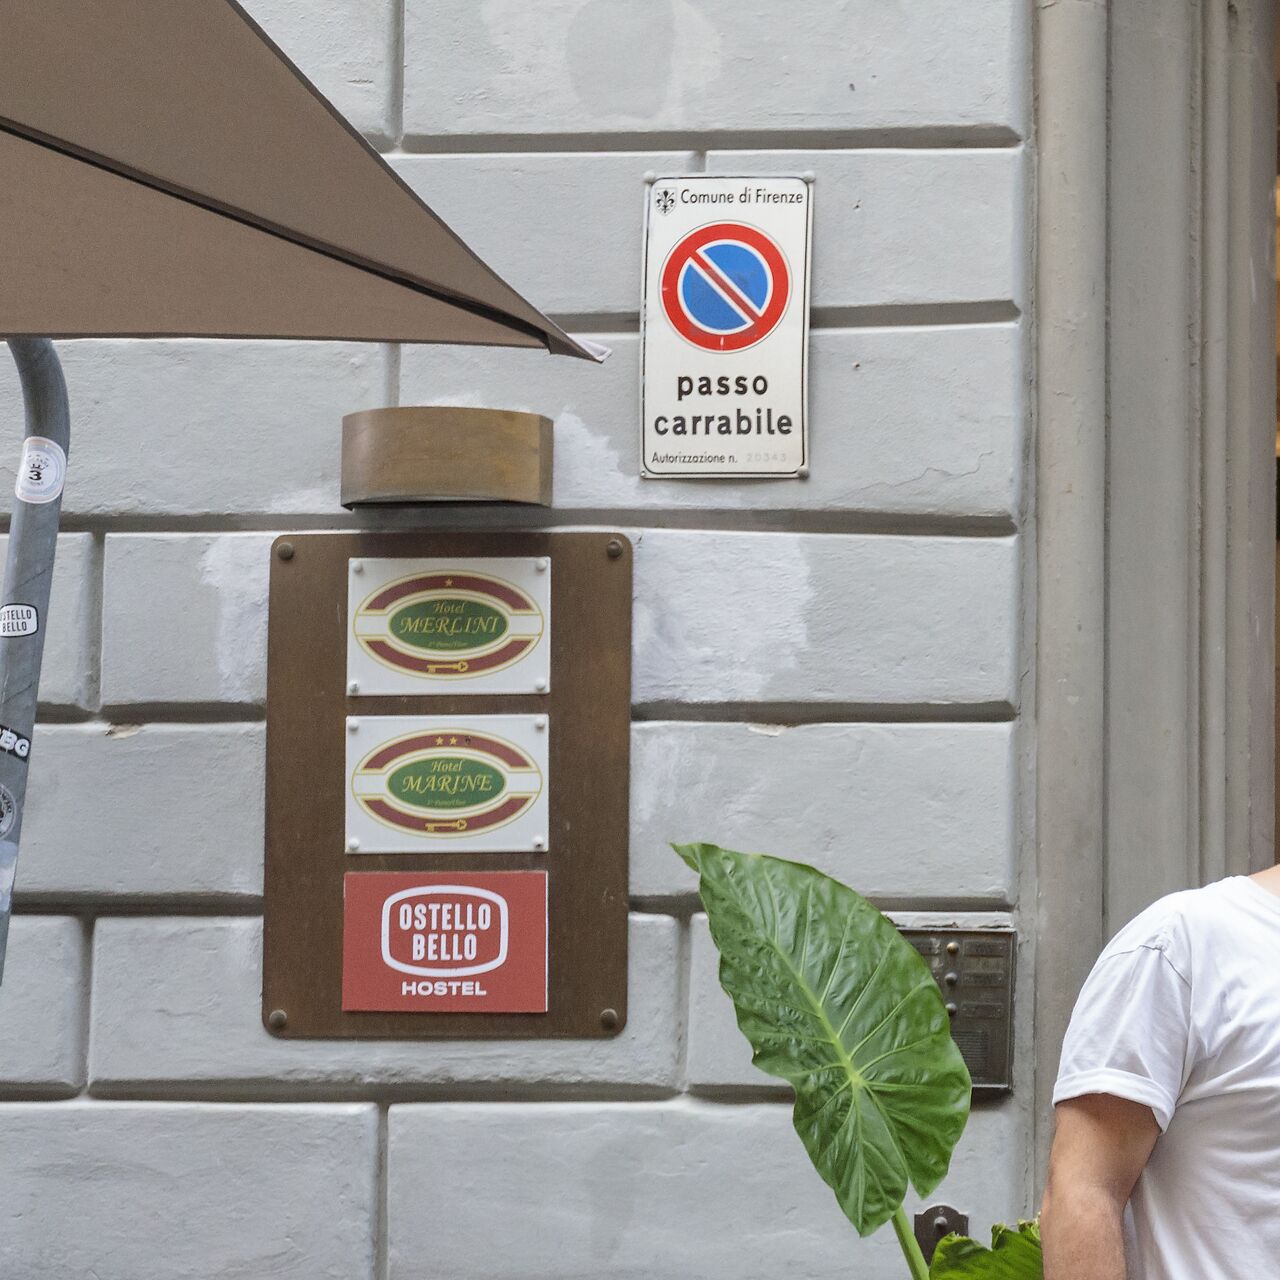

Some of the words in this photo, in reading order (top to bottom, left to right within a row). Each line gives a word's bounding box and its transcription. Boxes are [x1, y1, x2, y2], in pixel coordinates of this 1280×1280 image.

[681, 188, 734, 204] Comune
[739, 187, 751, 204] di
[756, 188, 803, 204] Firenze
[677, 374, 768, 401] passo
[654, 408, 793, 435] carrabile
[651, 451, 725, 464] Autorizzazione
[728, 456, 738, 464] n.
[28, 470, 42, 481] 3
[0, 609, 32, 620] STELLO
[432, 602, 466, 614] Hotel
[3, 621, 28, 632] BELLO
[400, 616, 499, 636] MERLINI
[432, 759, 464, 773] Hotel
[401, 774, 493, 795] MARINE
[399, 903, 492, 931] OSTELLO
[412, 933, 478, 961] BELLO
[401, 981, 487, 996] HOSTEL
